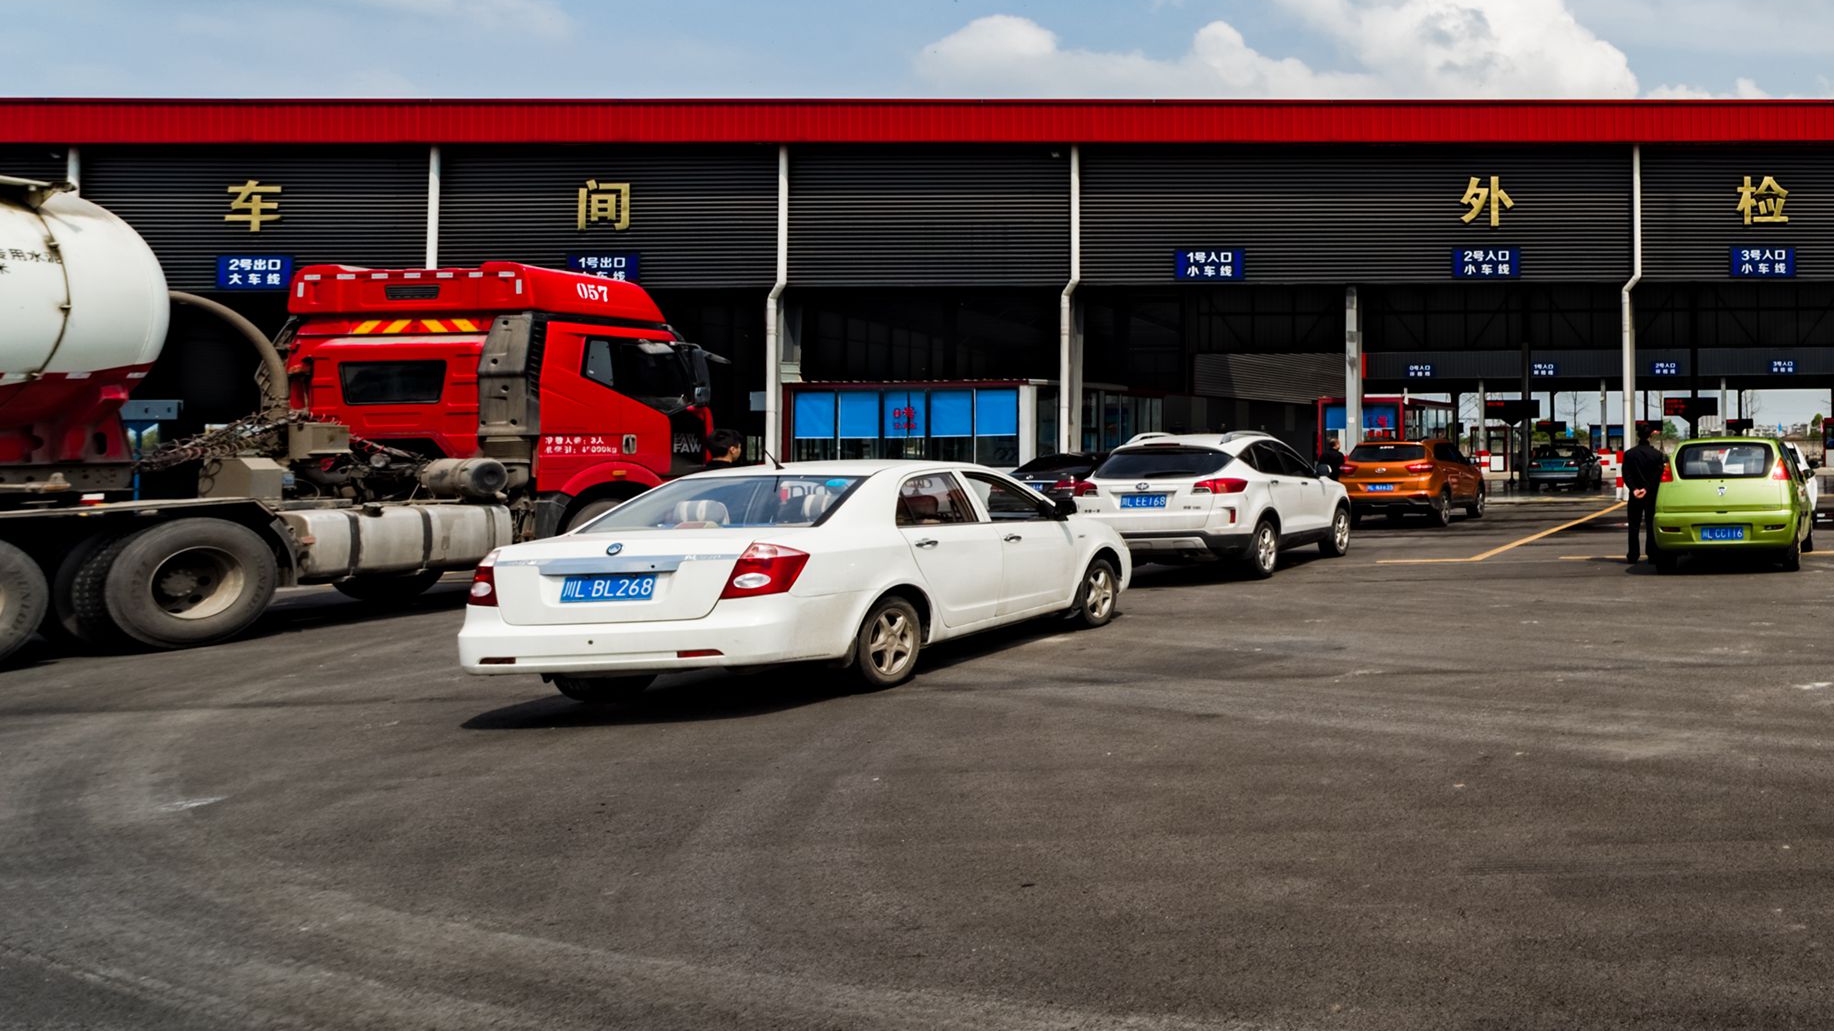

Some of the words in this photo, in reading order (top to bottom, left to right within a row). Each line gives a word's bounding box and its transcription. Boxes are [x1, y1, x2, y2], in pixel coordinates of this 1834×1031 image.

[224, 180, 282, 232] 车
[578, 179, 630, 230] 间
[1460, 176, 1515, 226] 外
[1736, 176, 1789, 225] 检
[1186, 251, 1232, 263] 1号入口
[1463, 250, 1510, 261] 2号入口
[1741, 249, 1786, 261] 3号入口
[228, 259, 281, 271] 2号出口
[578, 256, 626, 268] 1号出口
[1186, 265, 1232, 277] 小车线
[1463, 263, 1510, 275] 小车线
[1741, 263, 1786, 274] 小车线
[228, 273, 281, 285] 大车线
[576, 283, 609, 302] 057
[673, 443, 702, 454] FAW
